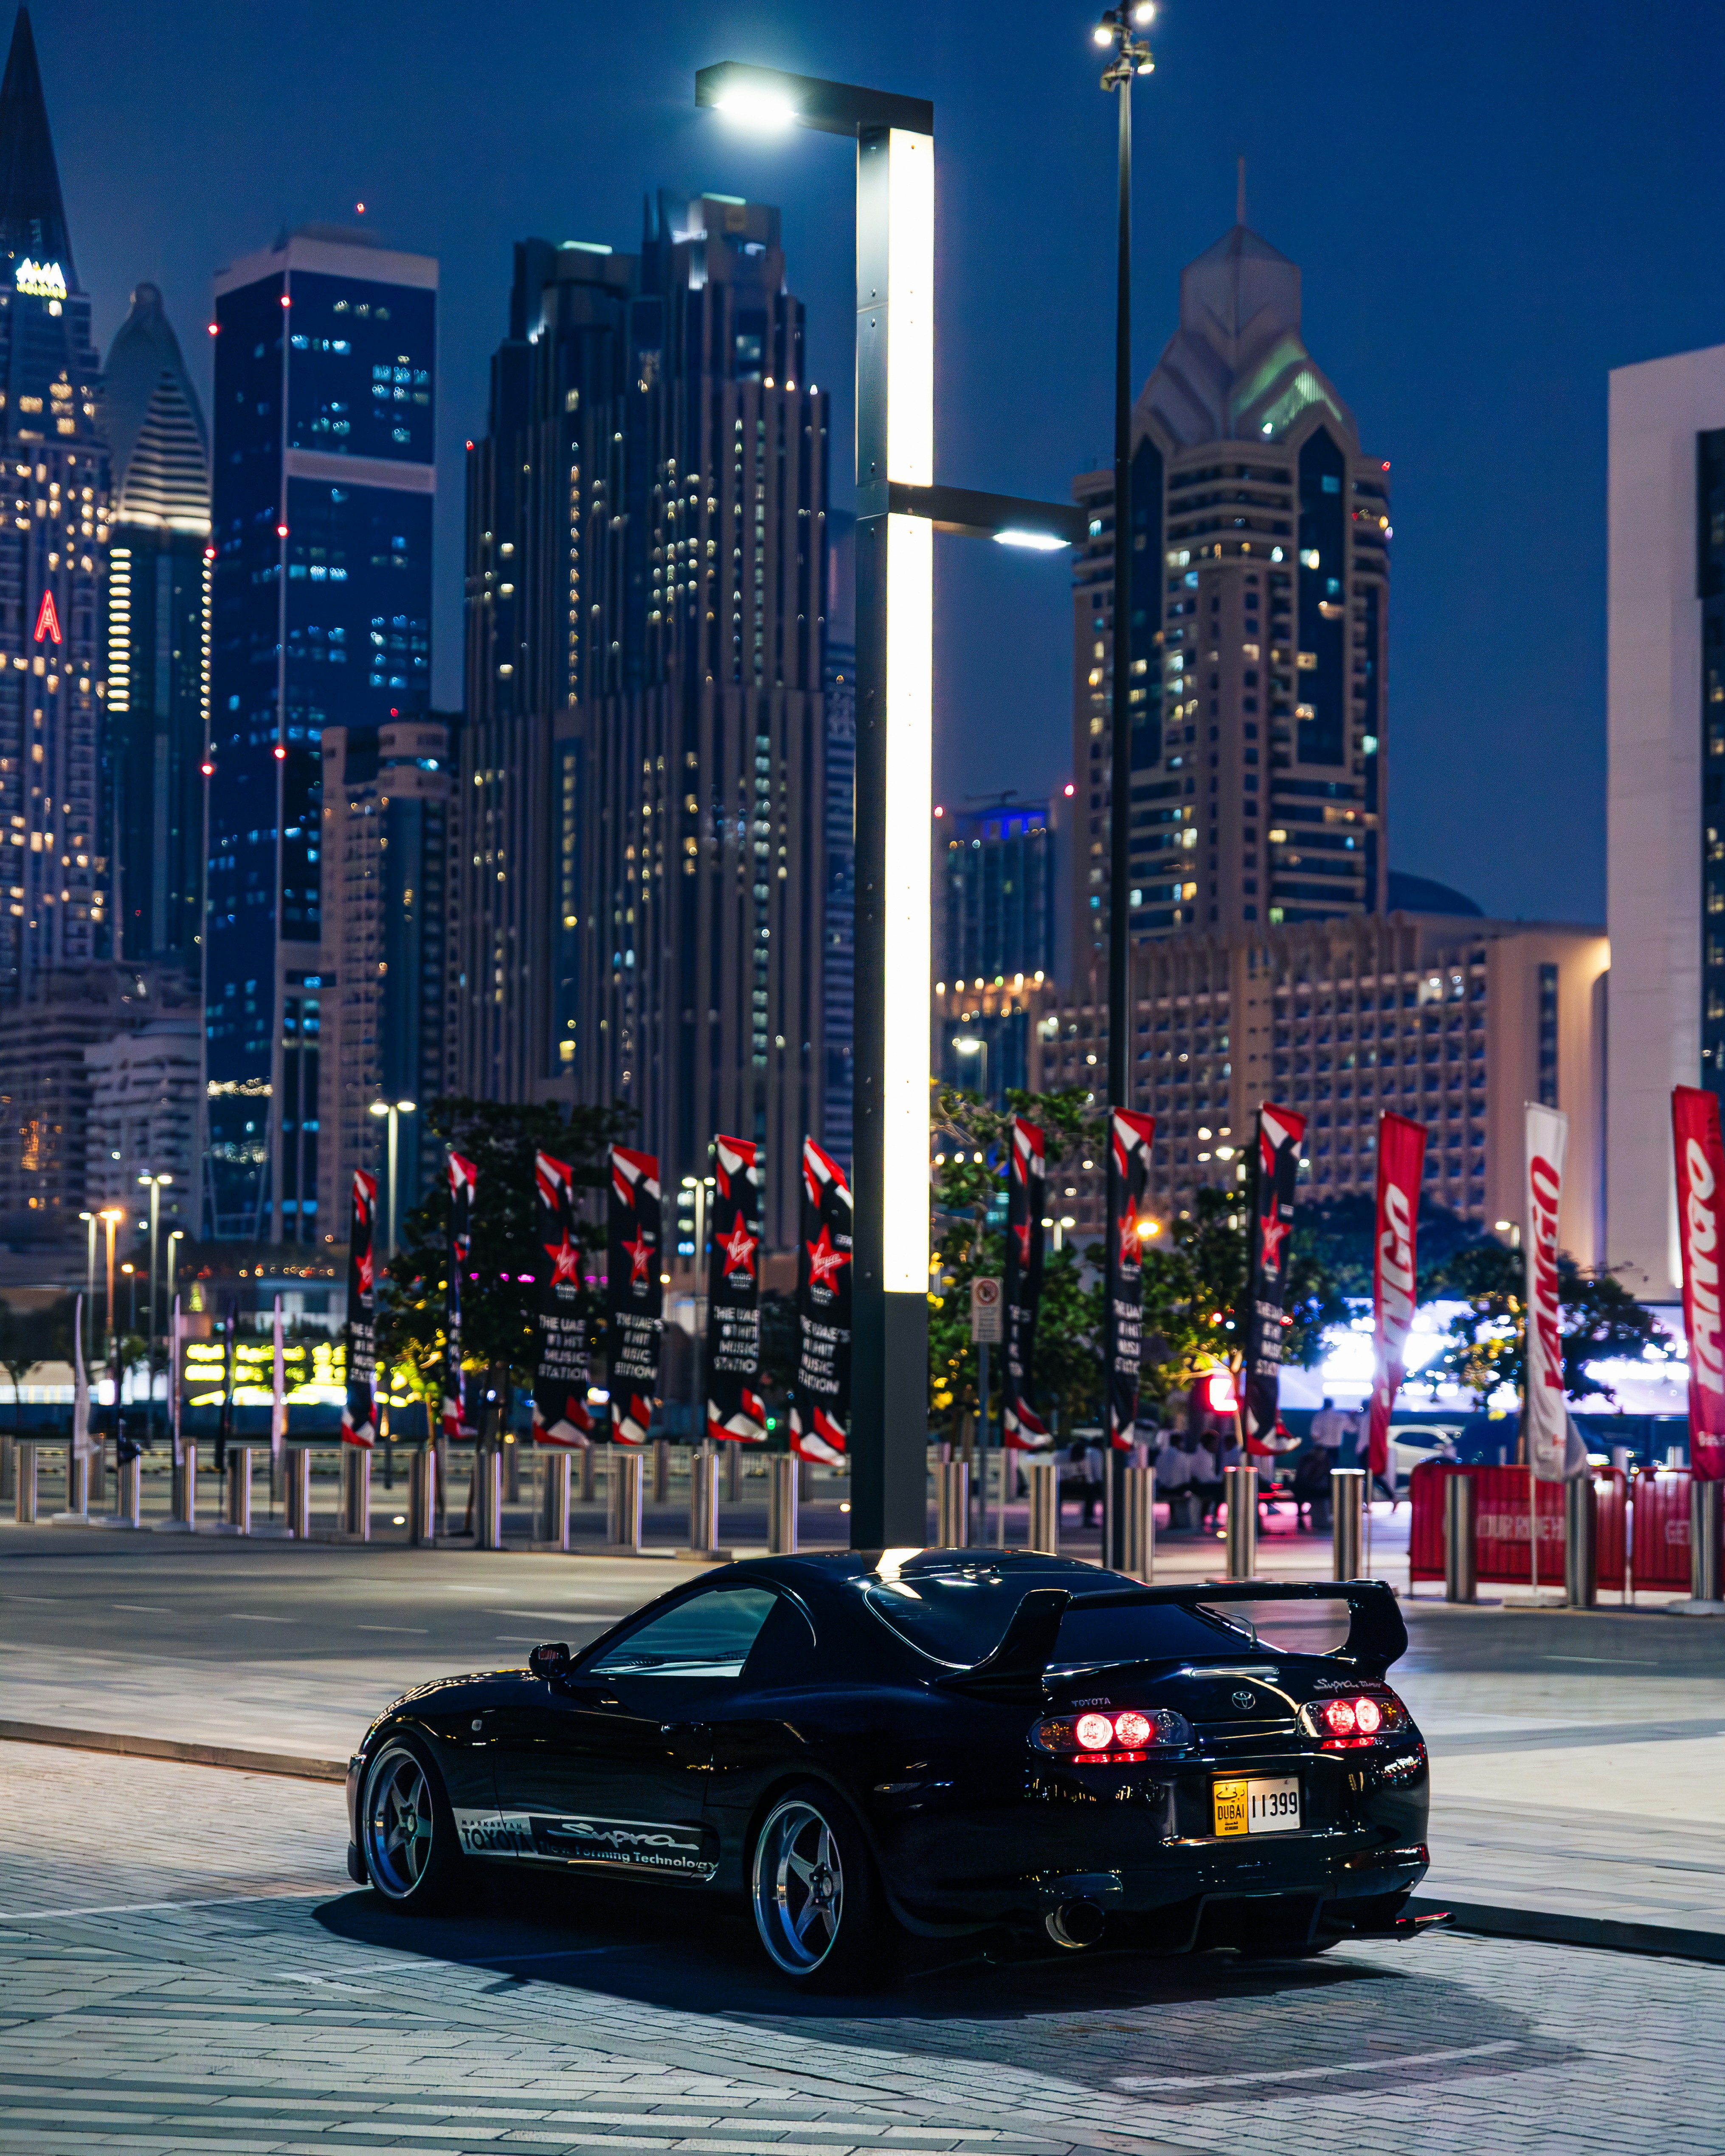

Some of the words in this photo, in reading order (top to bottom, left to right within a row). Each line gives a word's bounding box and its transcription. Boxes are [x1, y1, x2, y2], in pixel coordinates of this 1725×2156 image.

[1313, 1678, 1359, 1693] Supra
[1071, 1698, 1111, 1707] TOYOTA
[1218, 1804, 1244, 1820] DUBAI
[1252, 1792, 1297, 1818] 11399
[462, 1828, 534, 1852] TOYOTA
[547, 1823, 699, 1850] Supra
[633, 1852, 719, 1872] Technology
